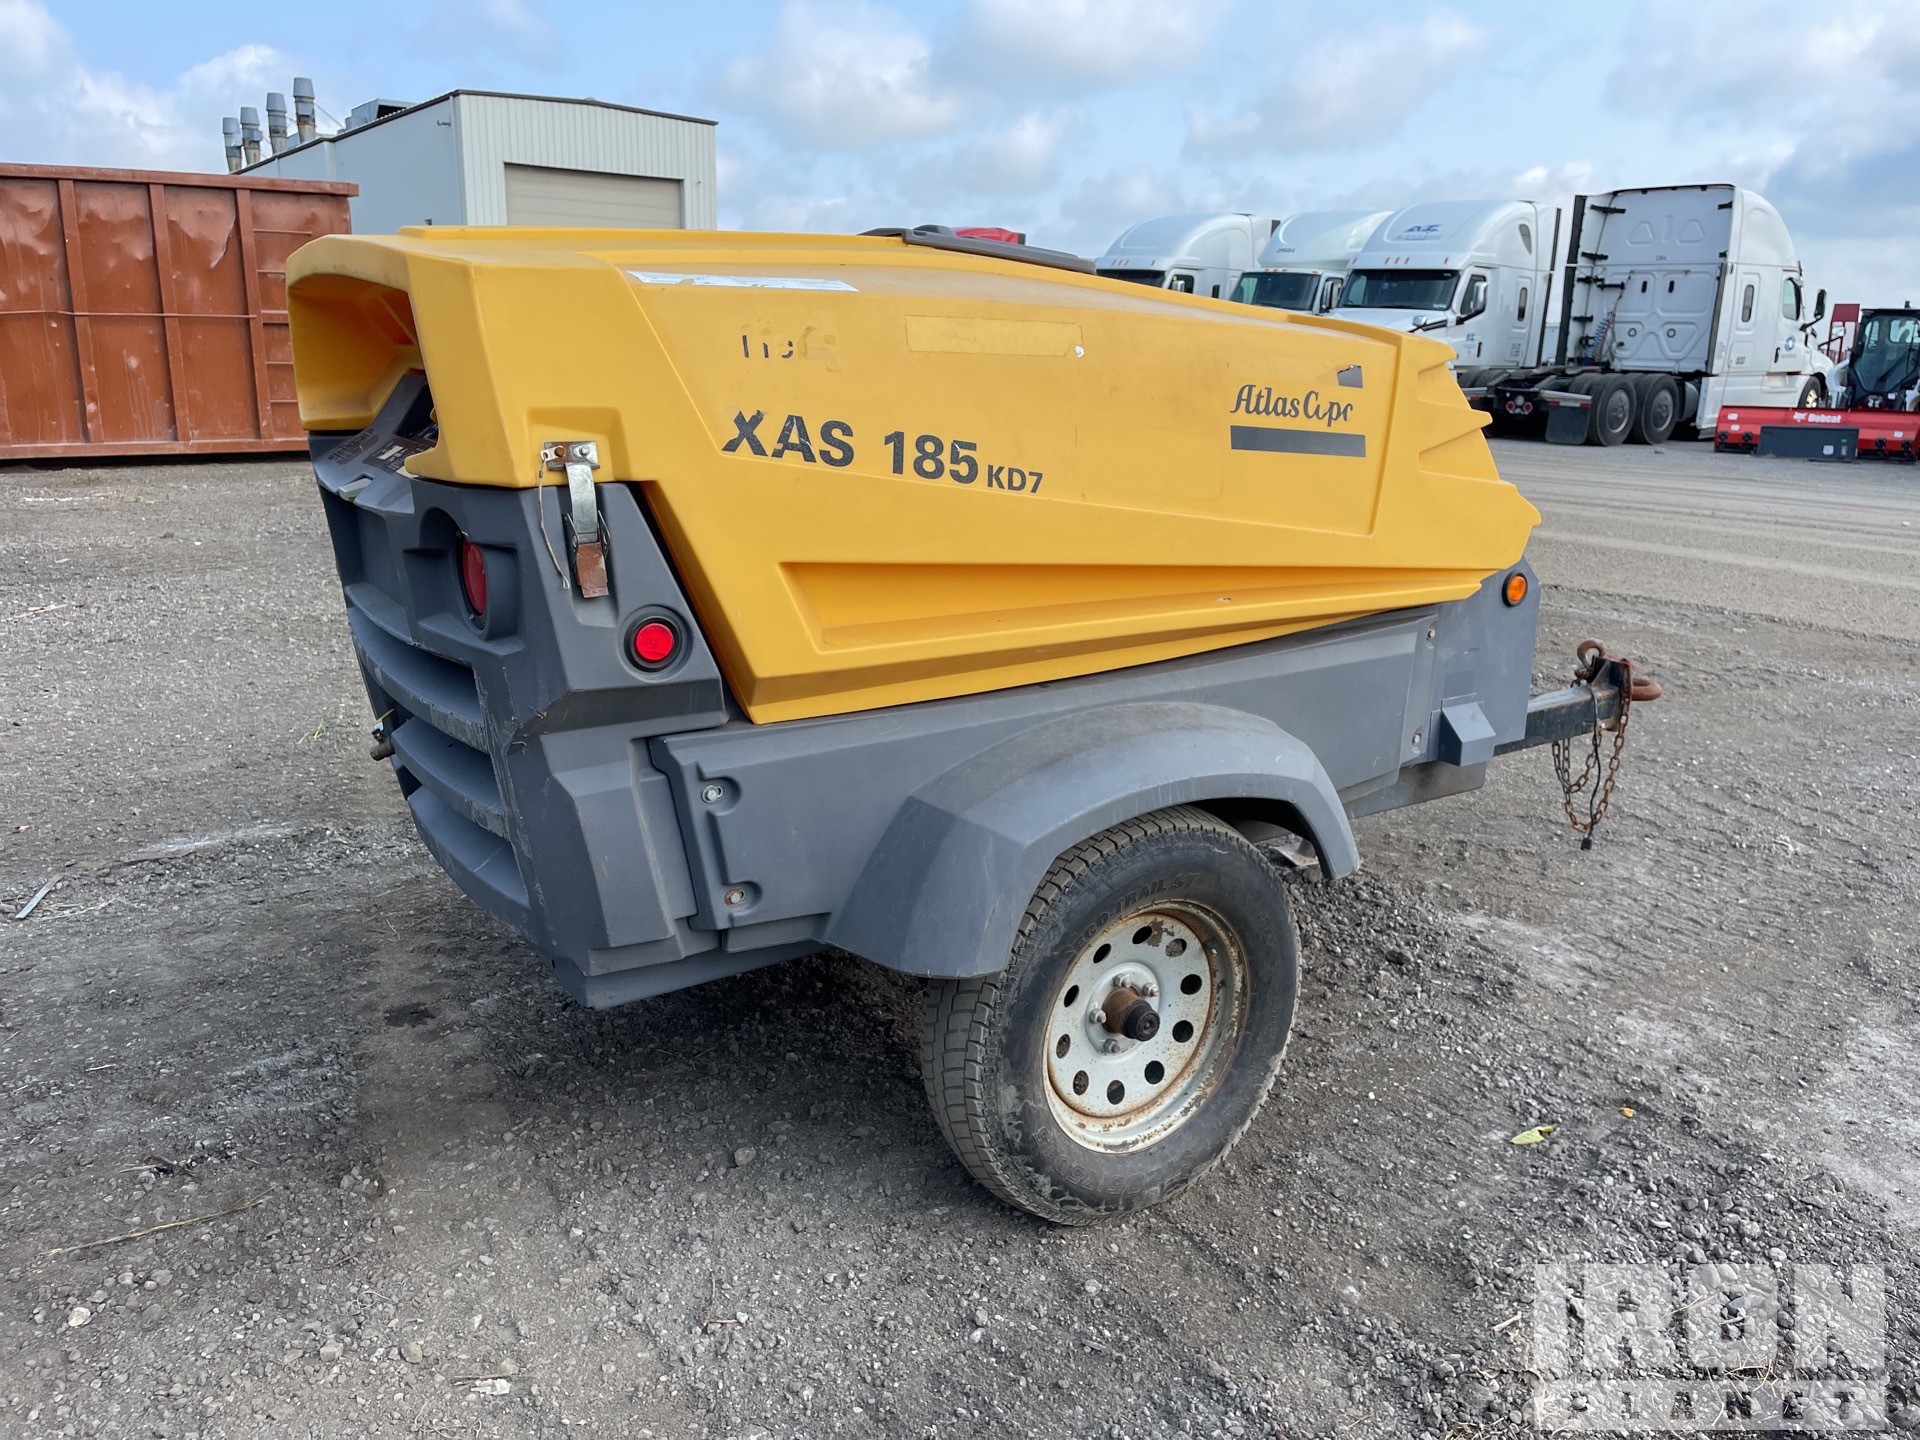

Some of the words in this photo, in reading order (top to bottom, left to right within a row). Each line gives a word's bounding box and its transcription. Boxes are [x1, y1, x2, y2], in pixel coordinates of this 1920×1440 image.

[1230, 384, 1300, 418] Atlas
[722, 410, 855, 467] XAS
[884, 431, 979, 484] 185
[987, 464, 1044, 494] KD7
